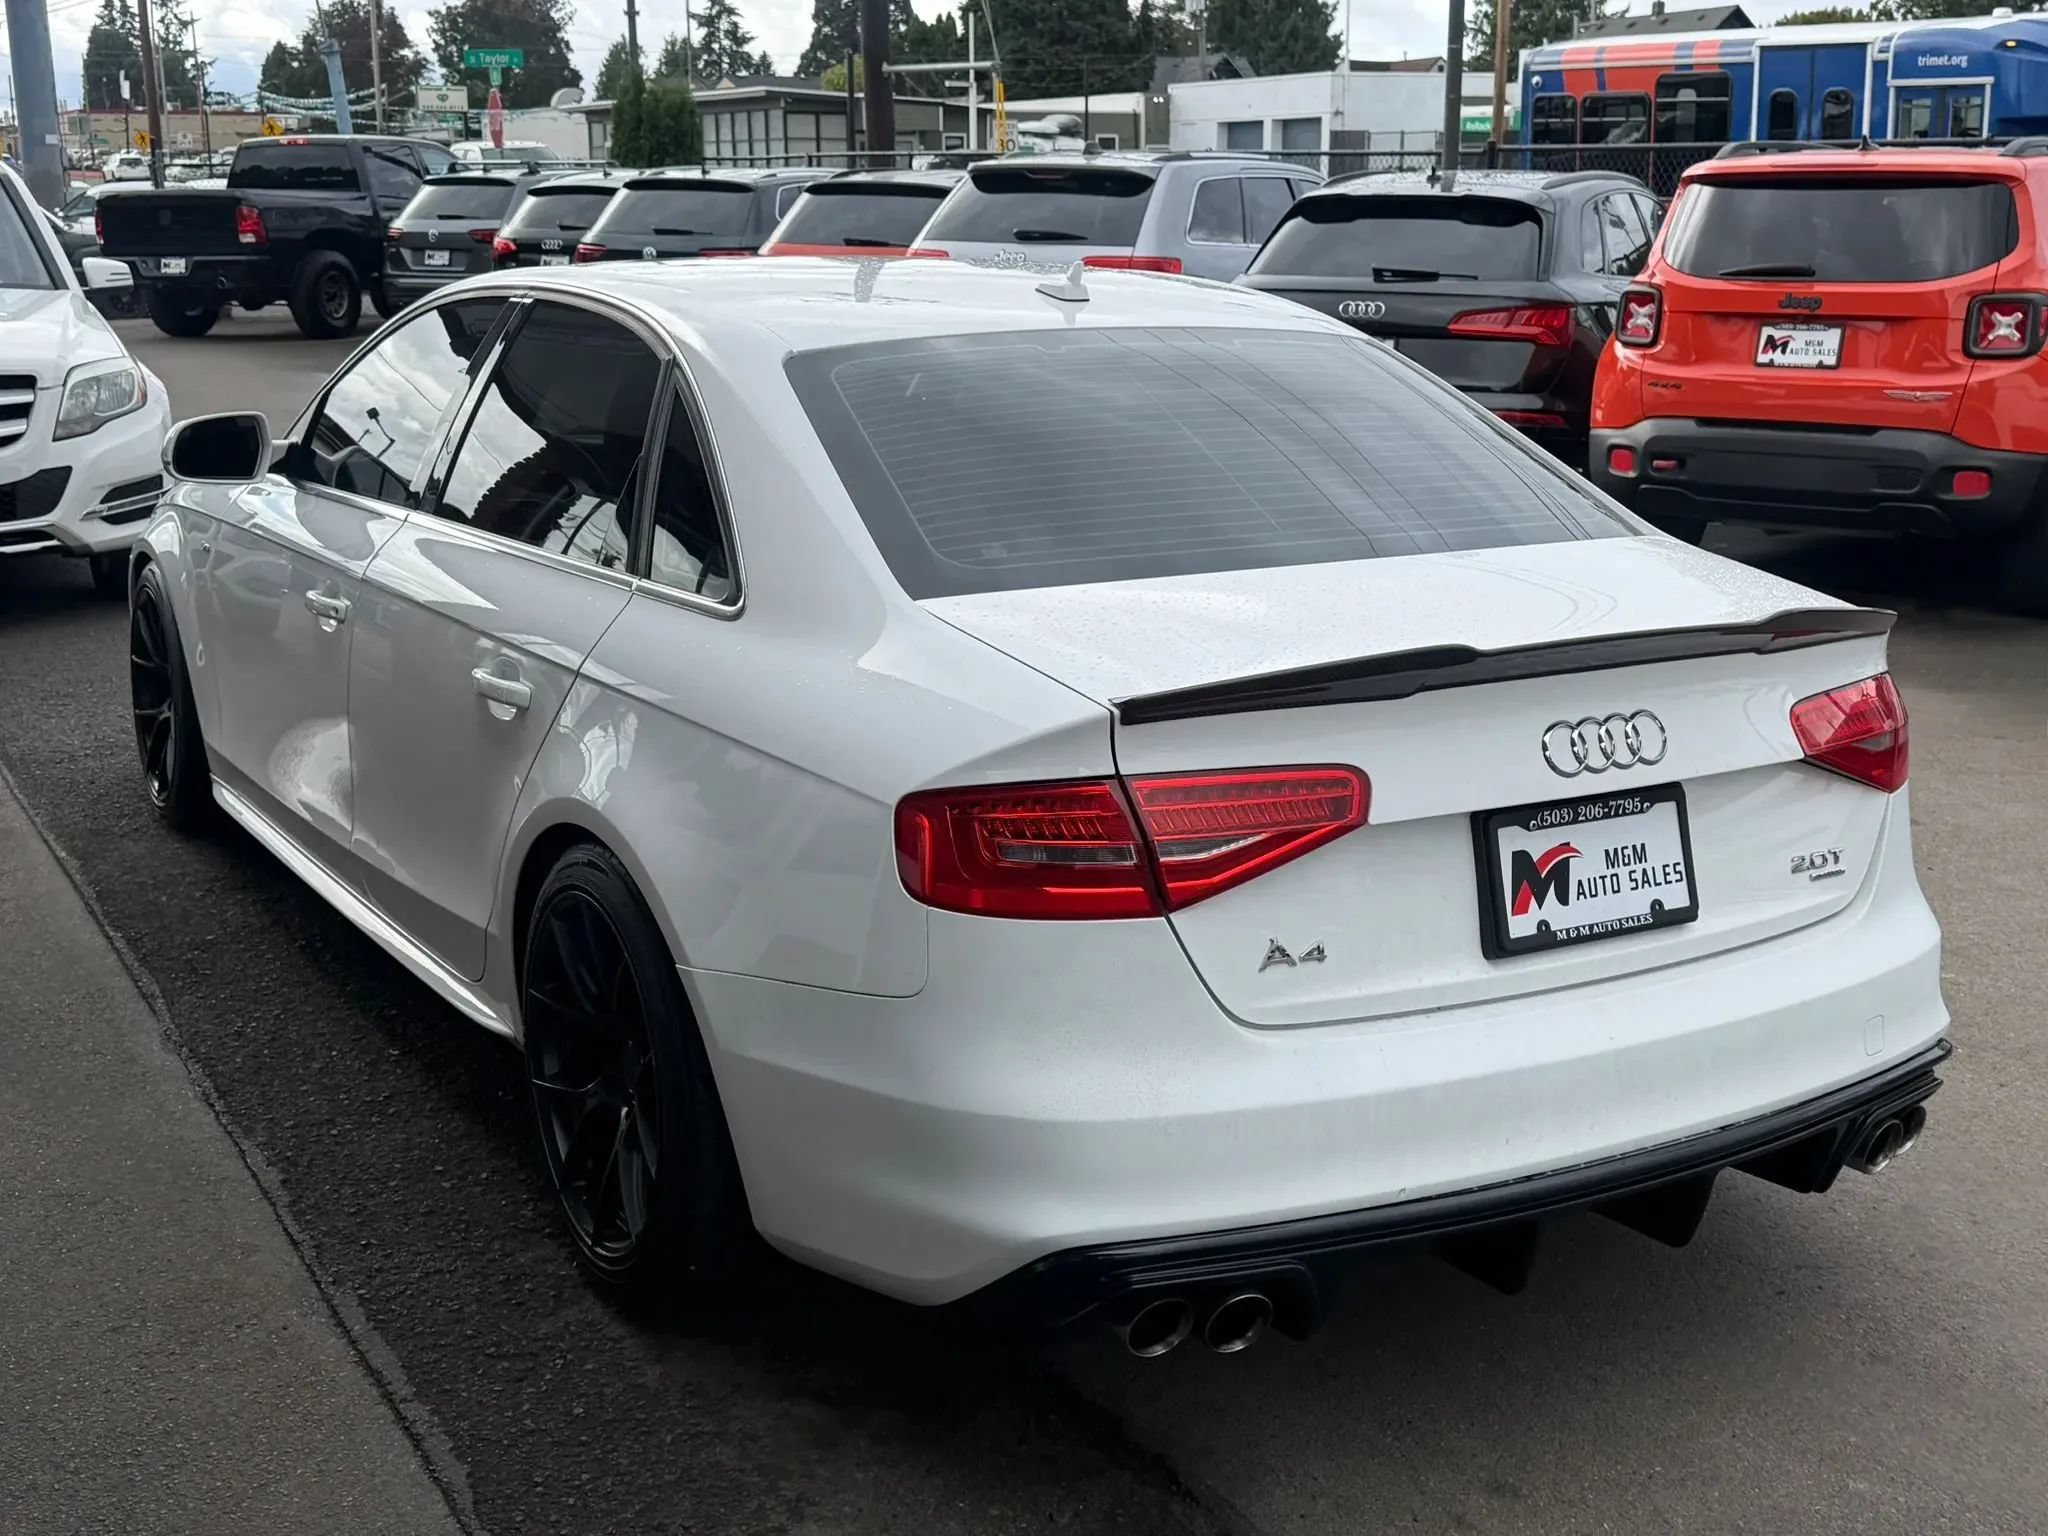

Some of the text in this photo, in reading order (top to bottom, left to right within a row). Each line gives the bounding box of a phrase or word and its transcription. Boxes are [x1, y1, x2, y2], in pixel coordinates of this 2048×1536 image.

[479, 53, 509, 65] Taylor
[1918, 53, 1968, 68] trimet.org
[1779, 292, 1822, 312] Jeep
[1790, 347, 1837, 357] AUTO SALES
[1537, 797, 1641, 827] (503) 206-7795
[1604, 843, 1648, 870] M&M
[1576, 862, 1684, 901] AUTO SALES
[1556, 914, 1653, 941] M & M AUTO SALES
[1258, 937, 1328, 972] A4
